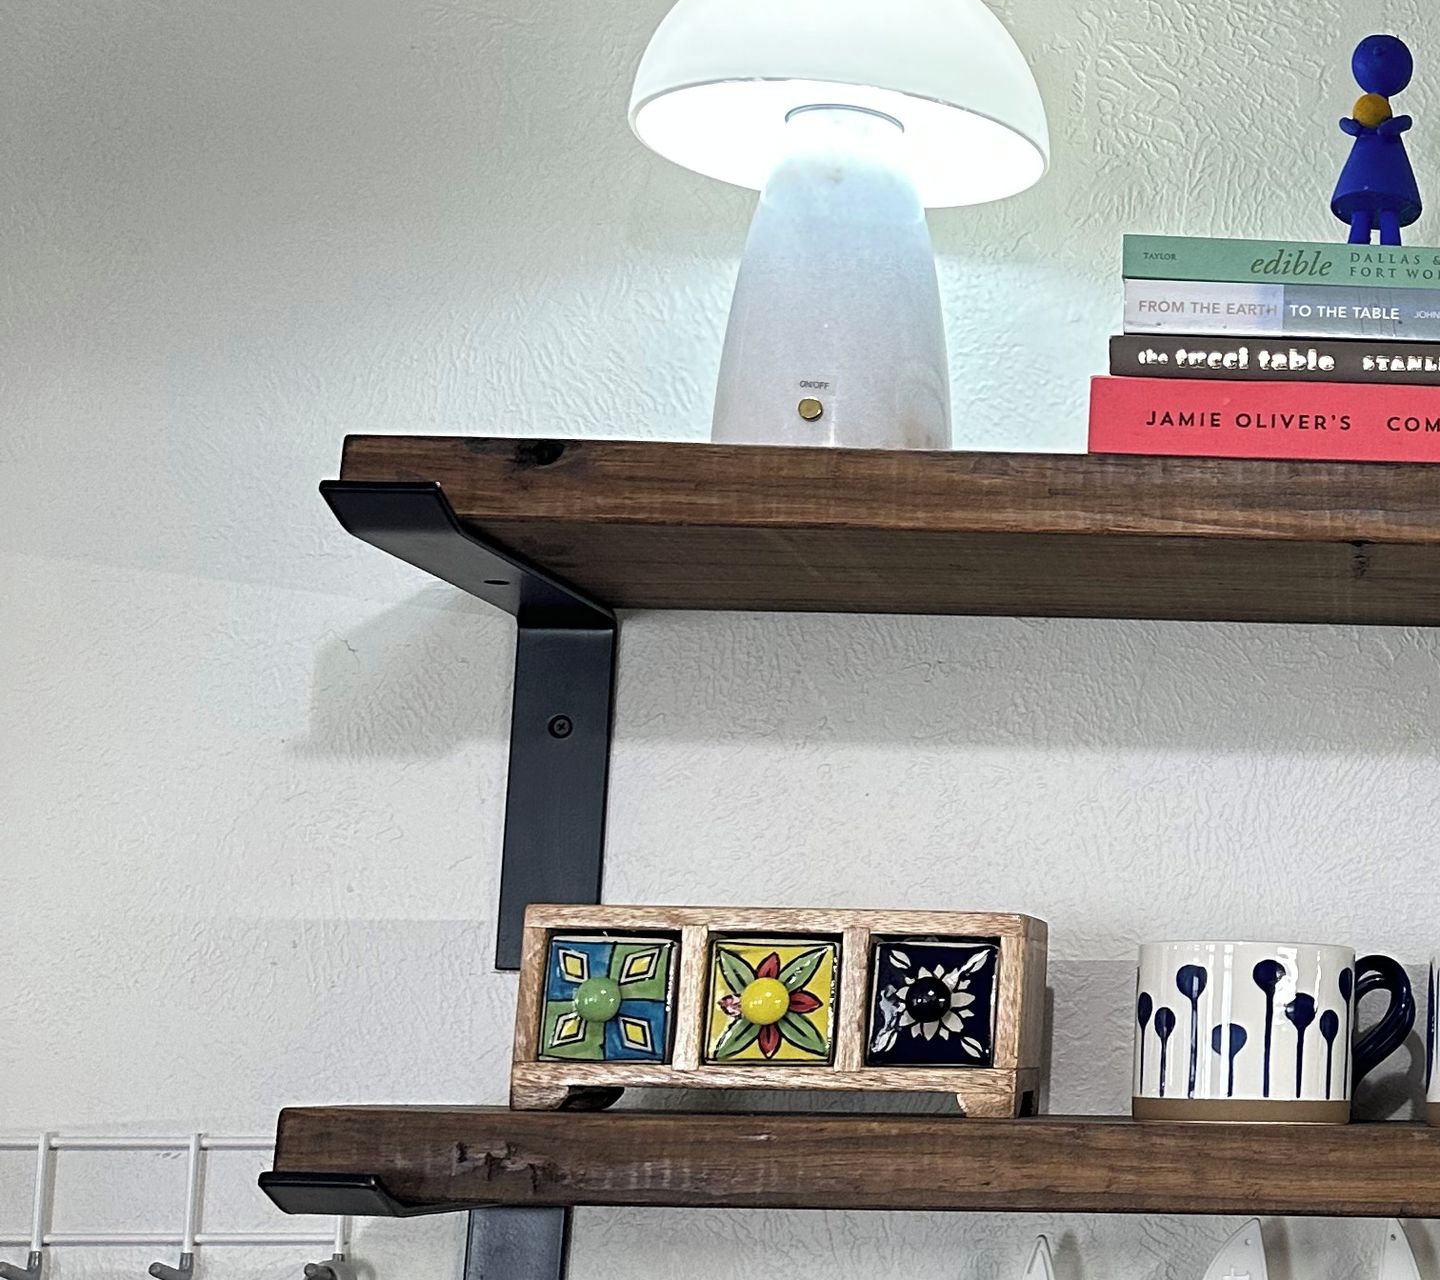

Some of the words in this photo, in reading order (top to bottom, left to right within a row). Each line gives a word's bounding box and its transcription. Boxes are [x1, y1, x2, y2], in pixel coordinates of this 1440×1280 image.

[1143, 252, 1177, 261] TAYLOR
[1250, 249, 1333, 277] edible
[1350, 252, 1421, 265] DALLAS
[1350, 266, 1397, 279] FORT
[1138, 300, 1185, 313] FROM
[1190, 301, 1221, 314] THE
[1226, 303, 1278, 316] EARTH
[1289, 304, 1312, 318] TO
[1318, 305, 1348, 319] THE
[1352, 306, 1400, 320] TABLE
[1413, 310, 1440, 320] JOHN
[1138, 349, 1169, 365] the
[1174, 346, 1250, 369] tucci
[1257, 348, 1336, 371] table
[1146, 410, 1222, 427] JAMIE
[1235, 412, 1352, 431] OLIVER'S
